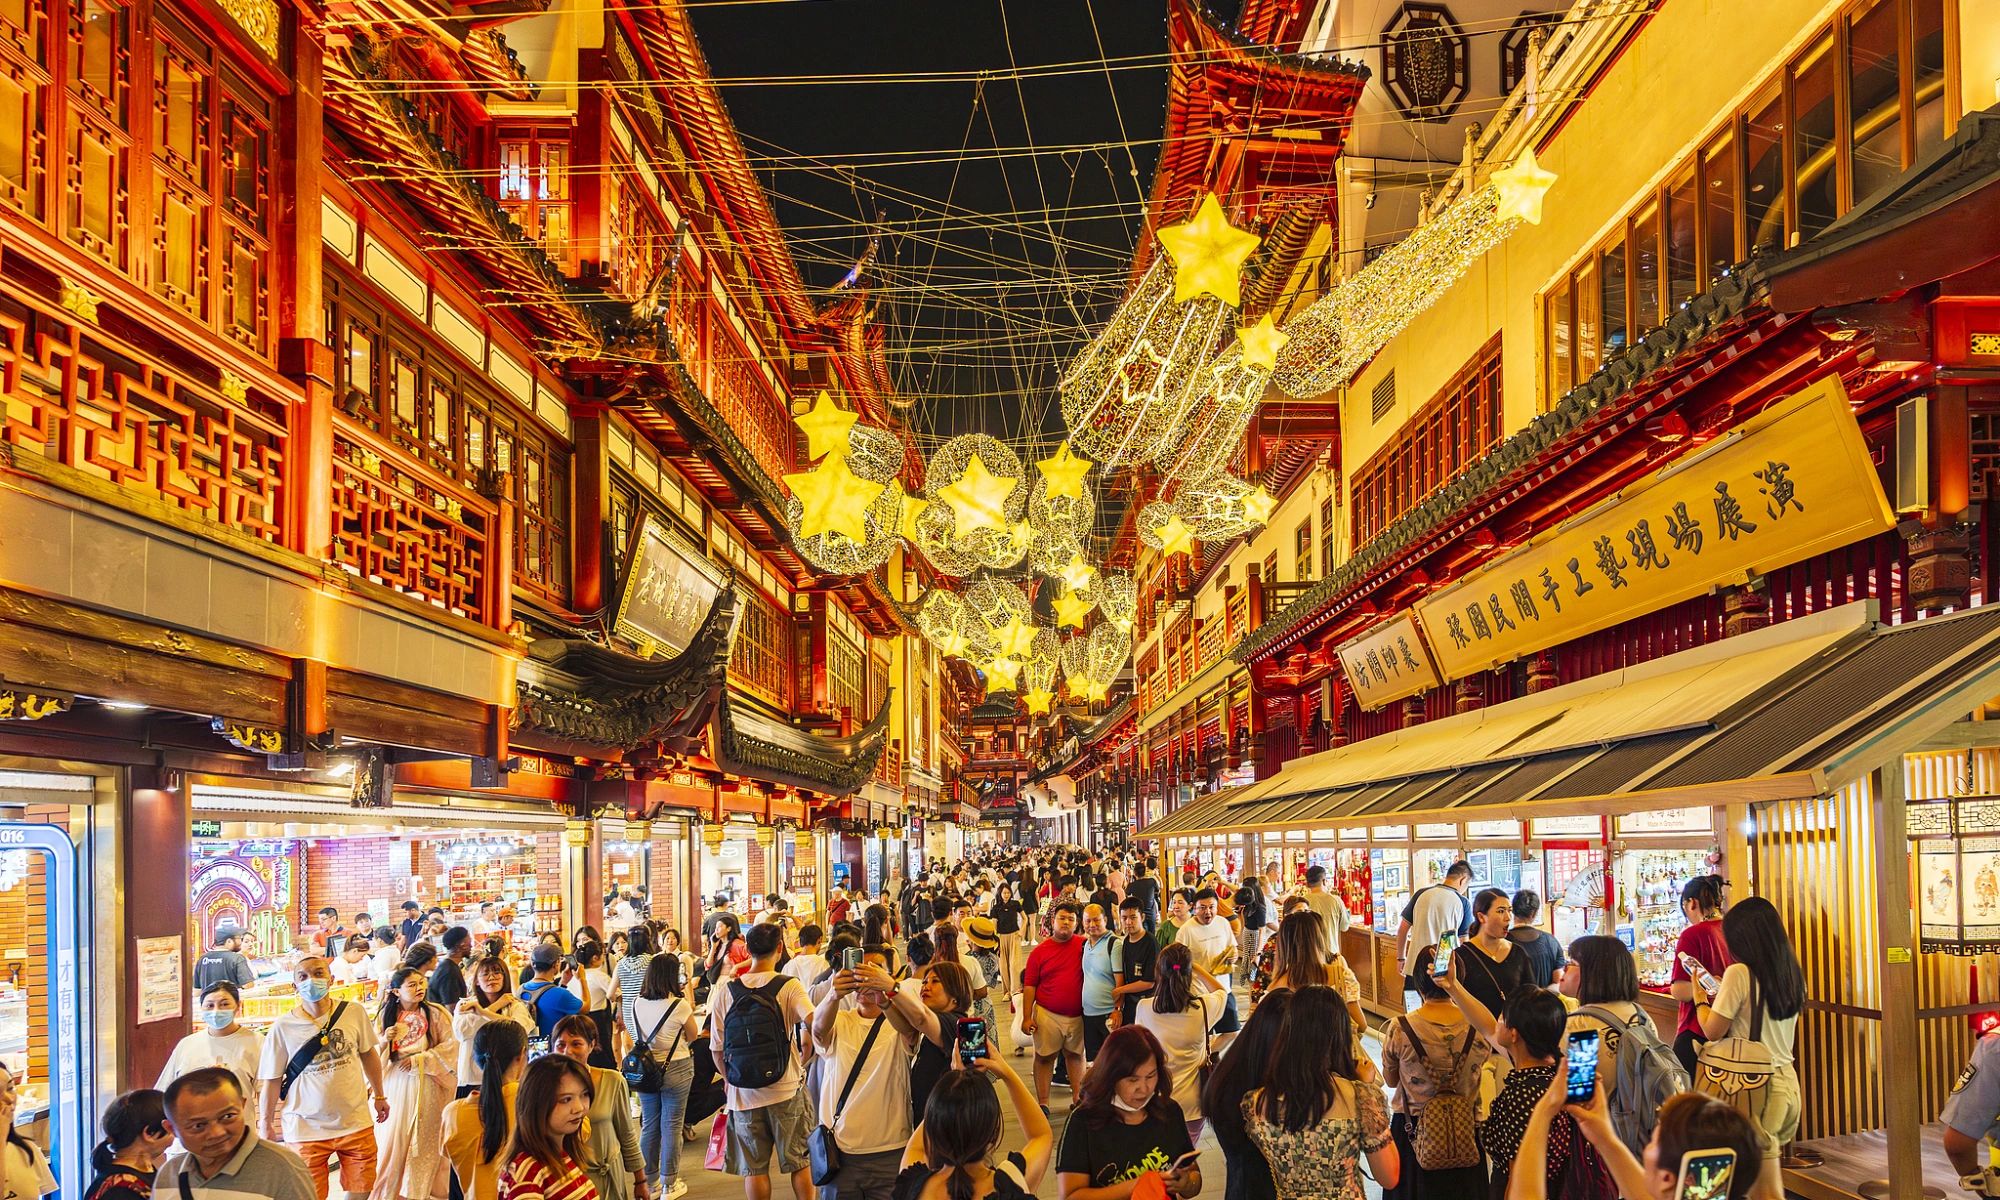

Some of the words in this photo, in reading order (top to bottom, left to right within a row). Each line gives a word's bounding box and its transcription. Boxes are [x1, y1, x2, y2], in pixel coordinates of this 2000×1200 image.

[59, 959, 74, 1093] 才有好味道
